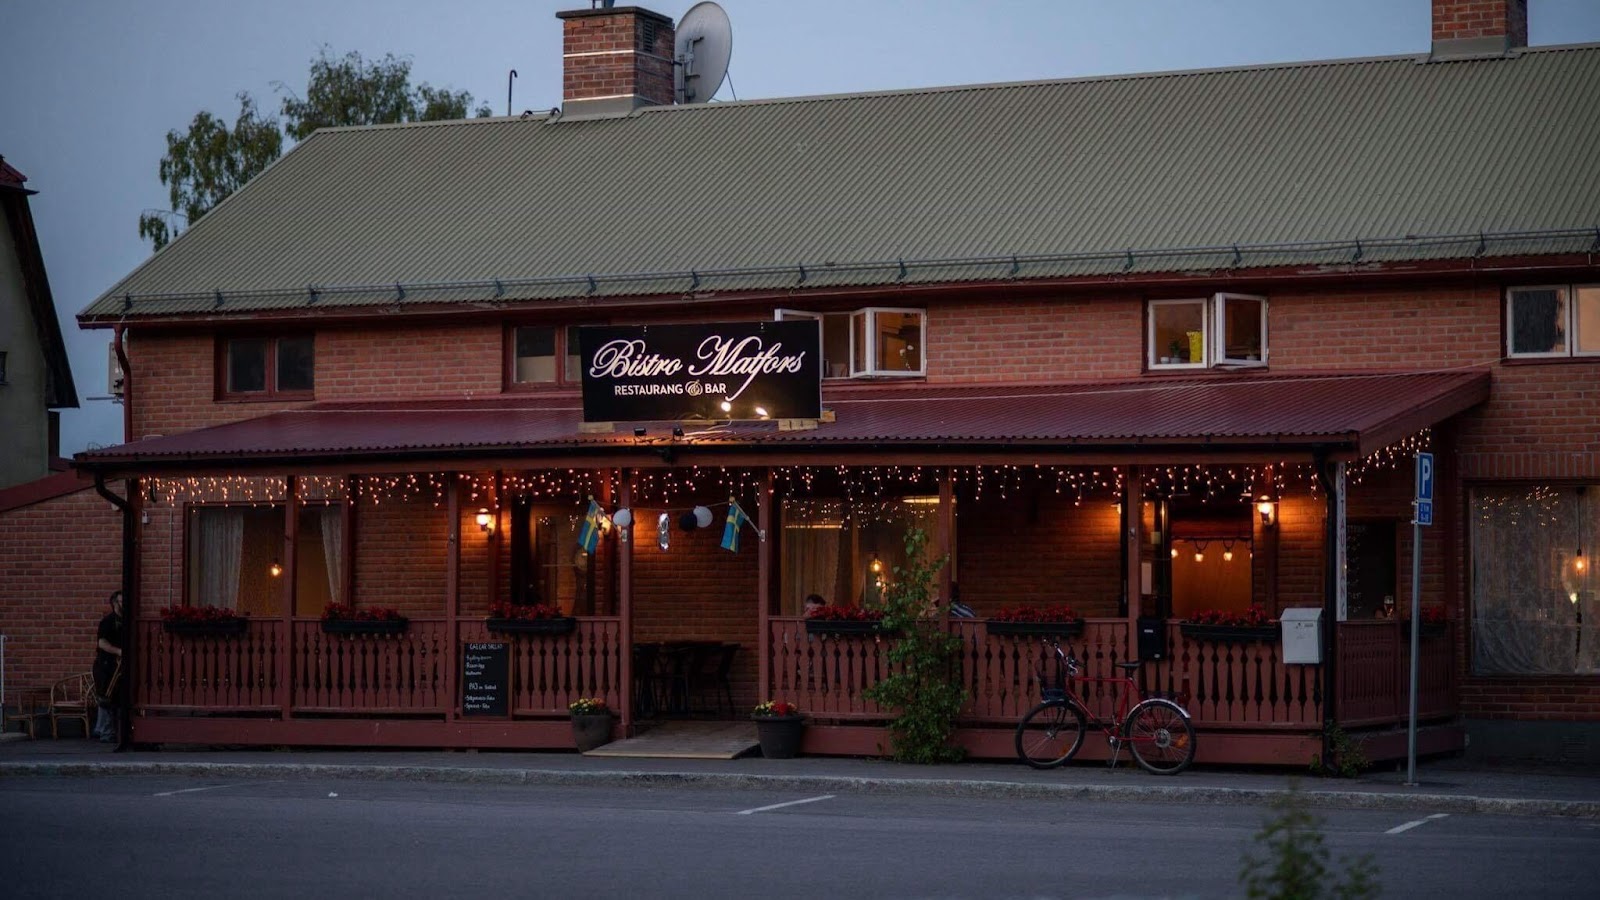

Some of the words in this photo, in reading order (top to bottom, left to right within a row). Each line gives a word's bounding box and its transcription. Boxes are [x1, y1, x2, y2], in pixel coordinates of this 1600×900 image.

[590, 339, 683, 377] Bistro
[688, 335, 806, 401] Matfors
[614, 383, 684, 396] RESTAURANG
[705, 383, 727, 394] BAR
[1422, 458, 1431, 495] P
